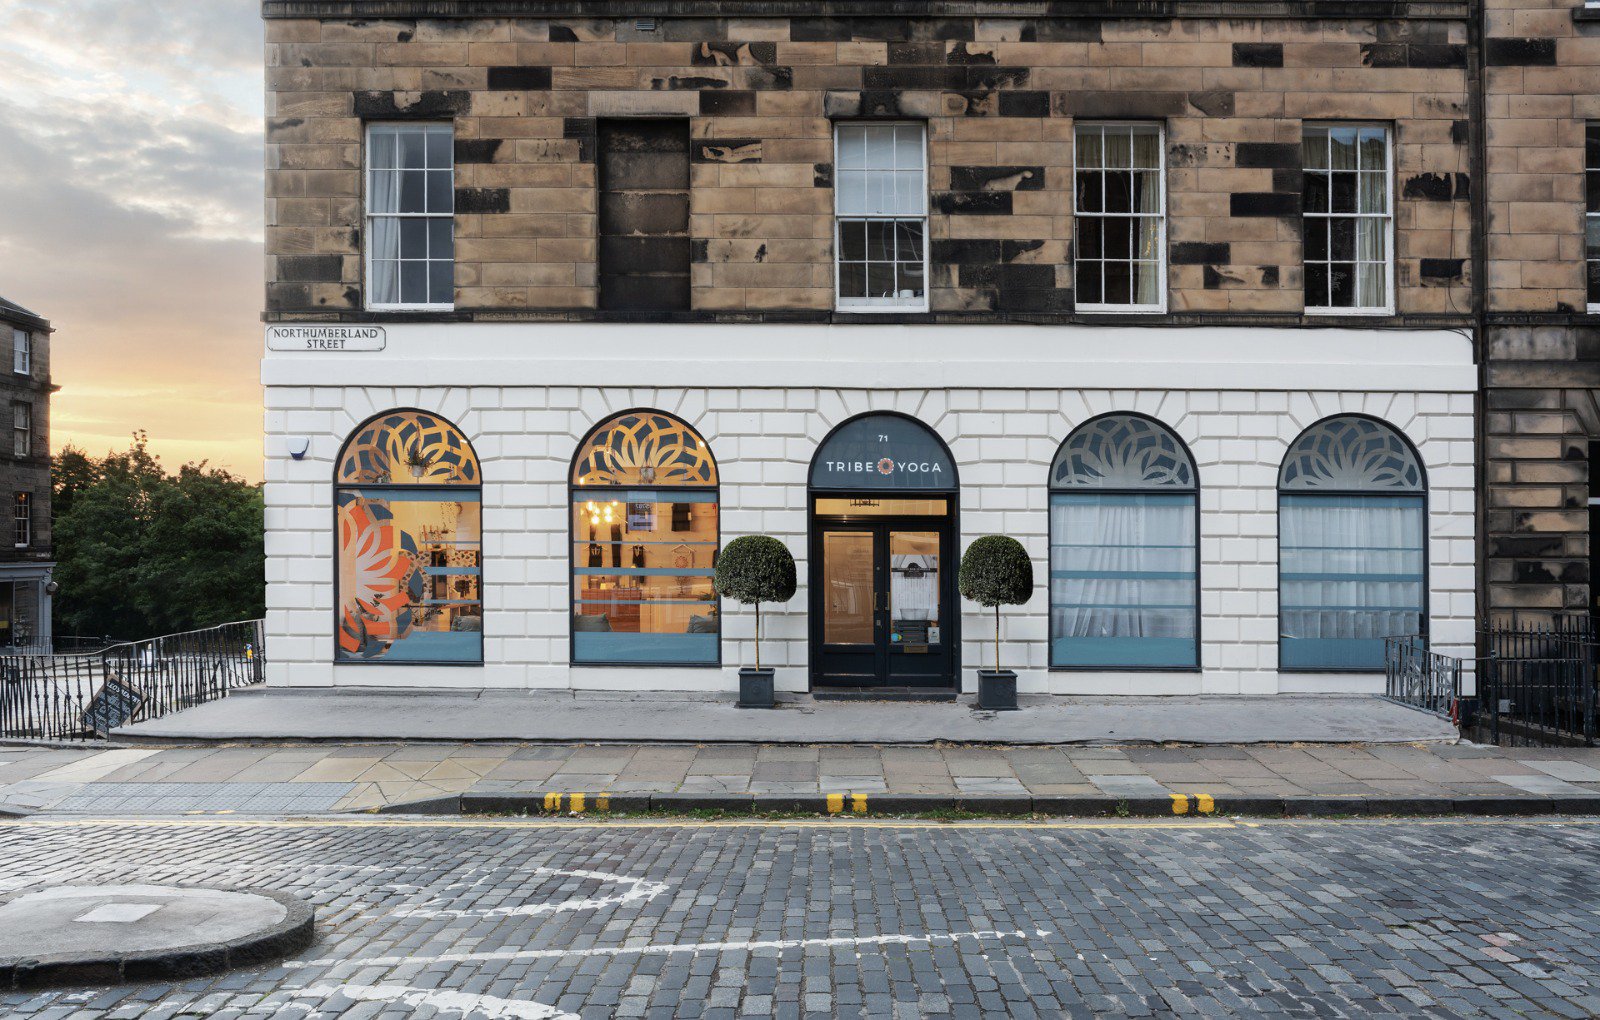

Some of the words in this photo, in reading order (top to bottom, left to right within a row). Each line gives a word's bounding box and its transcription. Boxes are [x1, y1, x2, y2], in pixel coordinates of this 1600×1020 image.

[273, 328, 378, 339] NORTHUMBERLAND
[306, 339, 346, 349] STREET
[878, 434, 888, 442] 71
[826, 461, 874, 472] TRIBE
[897, 462, 942, 473] YOGA
